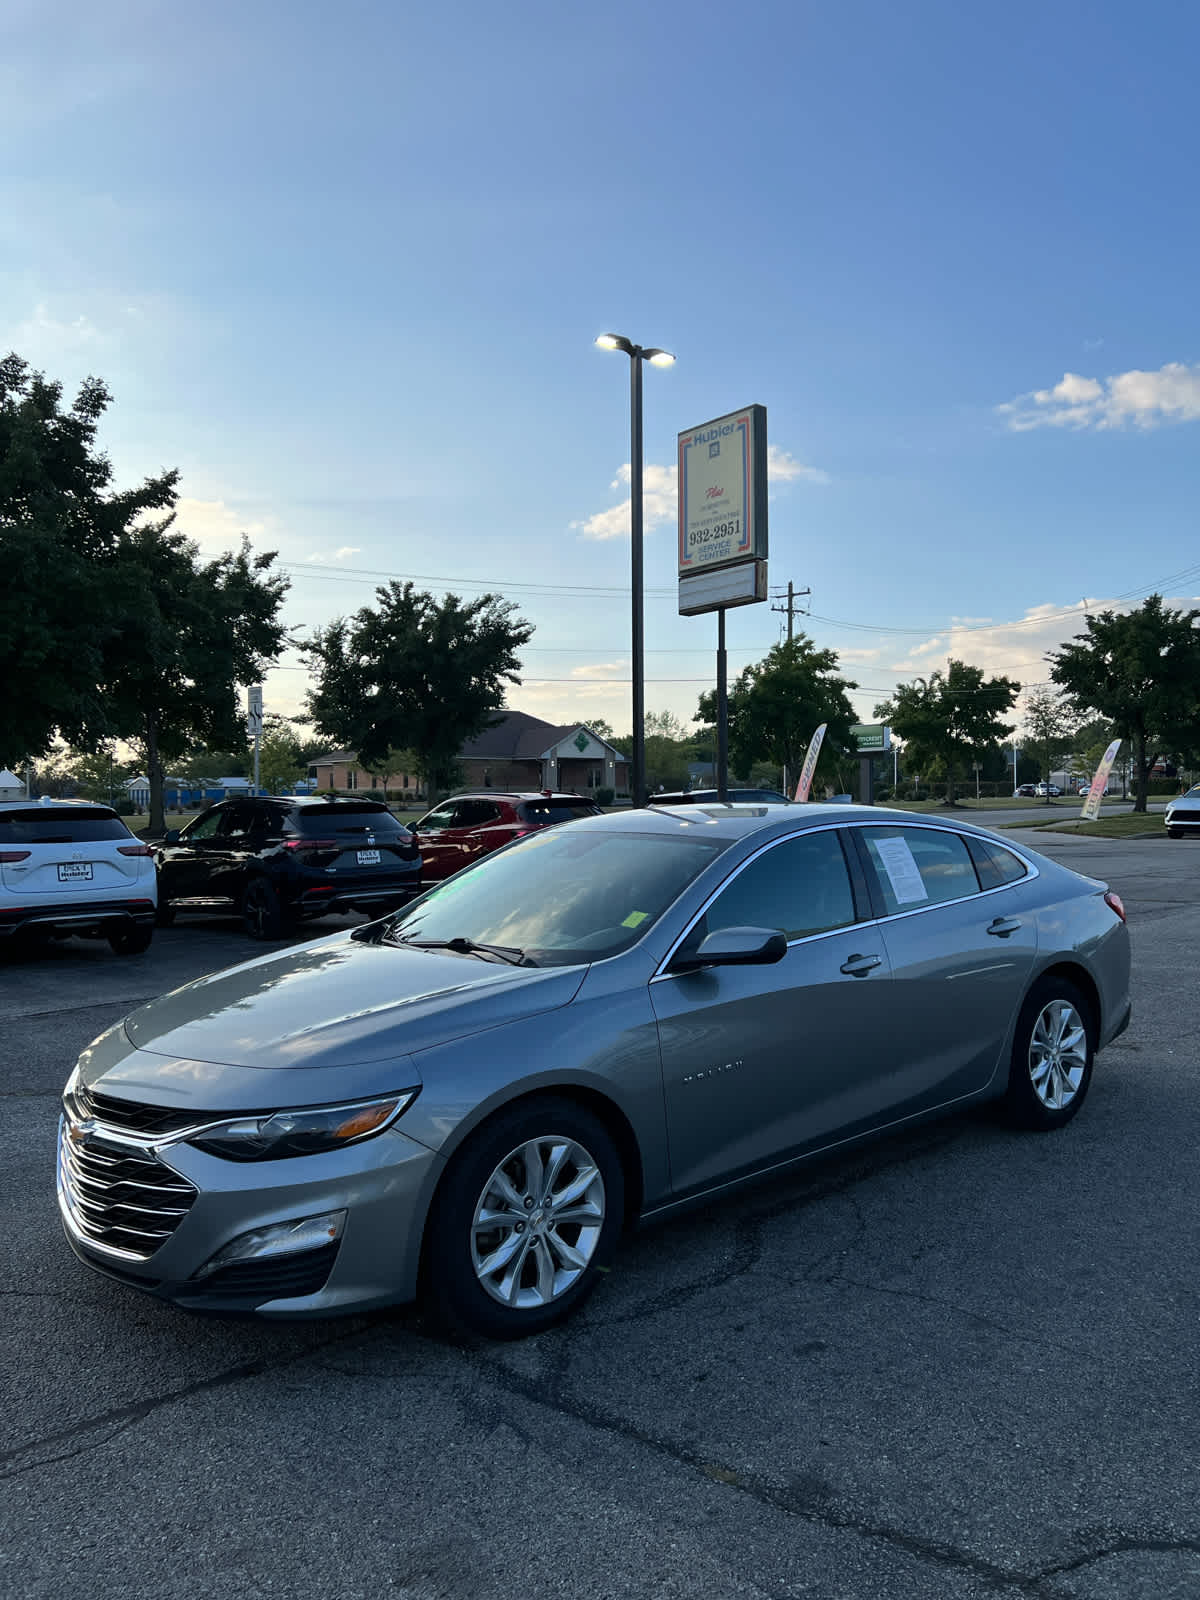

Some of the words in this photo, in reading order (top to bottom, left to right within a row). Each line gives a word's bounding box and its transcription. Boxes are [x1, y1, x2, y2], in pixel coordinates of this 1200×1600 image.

[689, 519, 740, 546] 932-2951
[698, 540, 731, 553] SERVICE
[698, 548, 731, 561] CENTER
